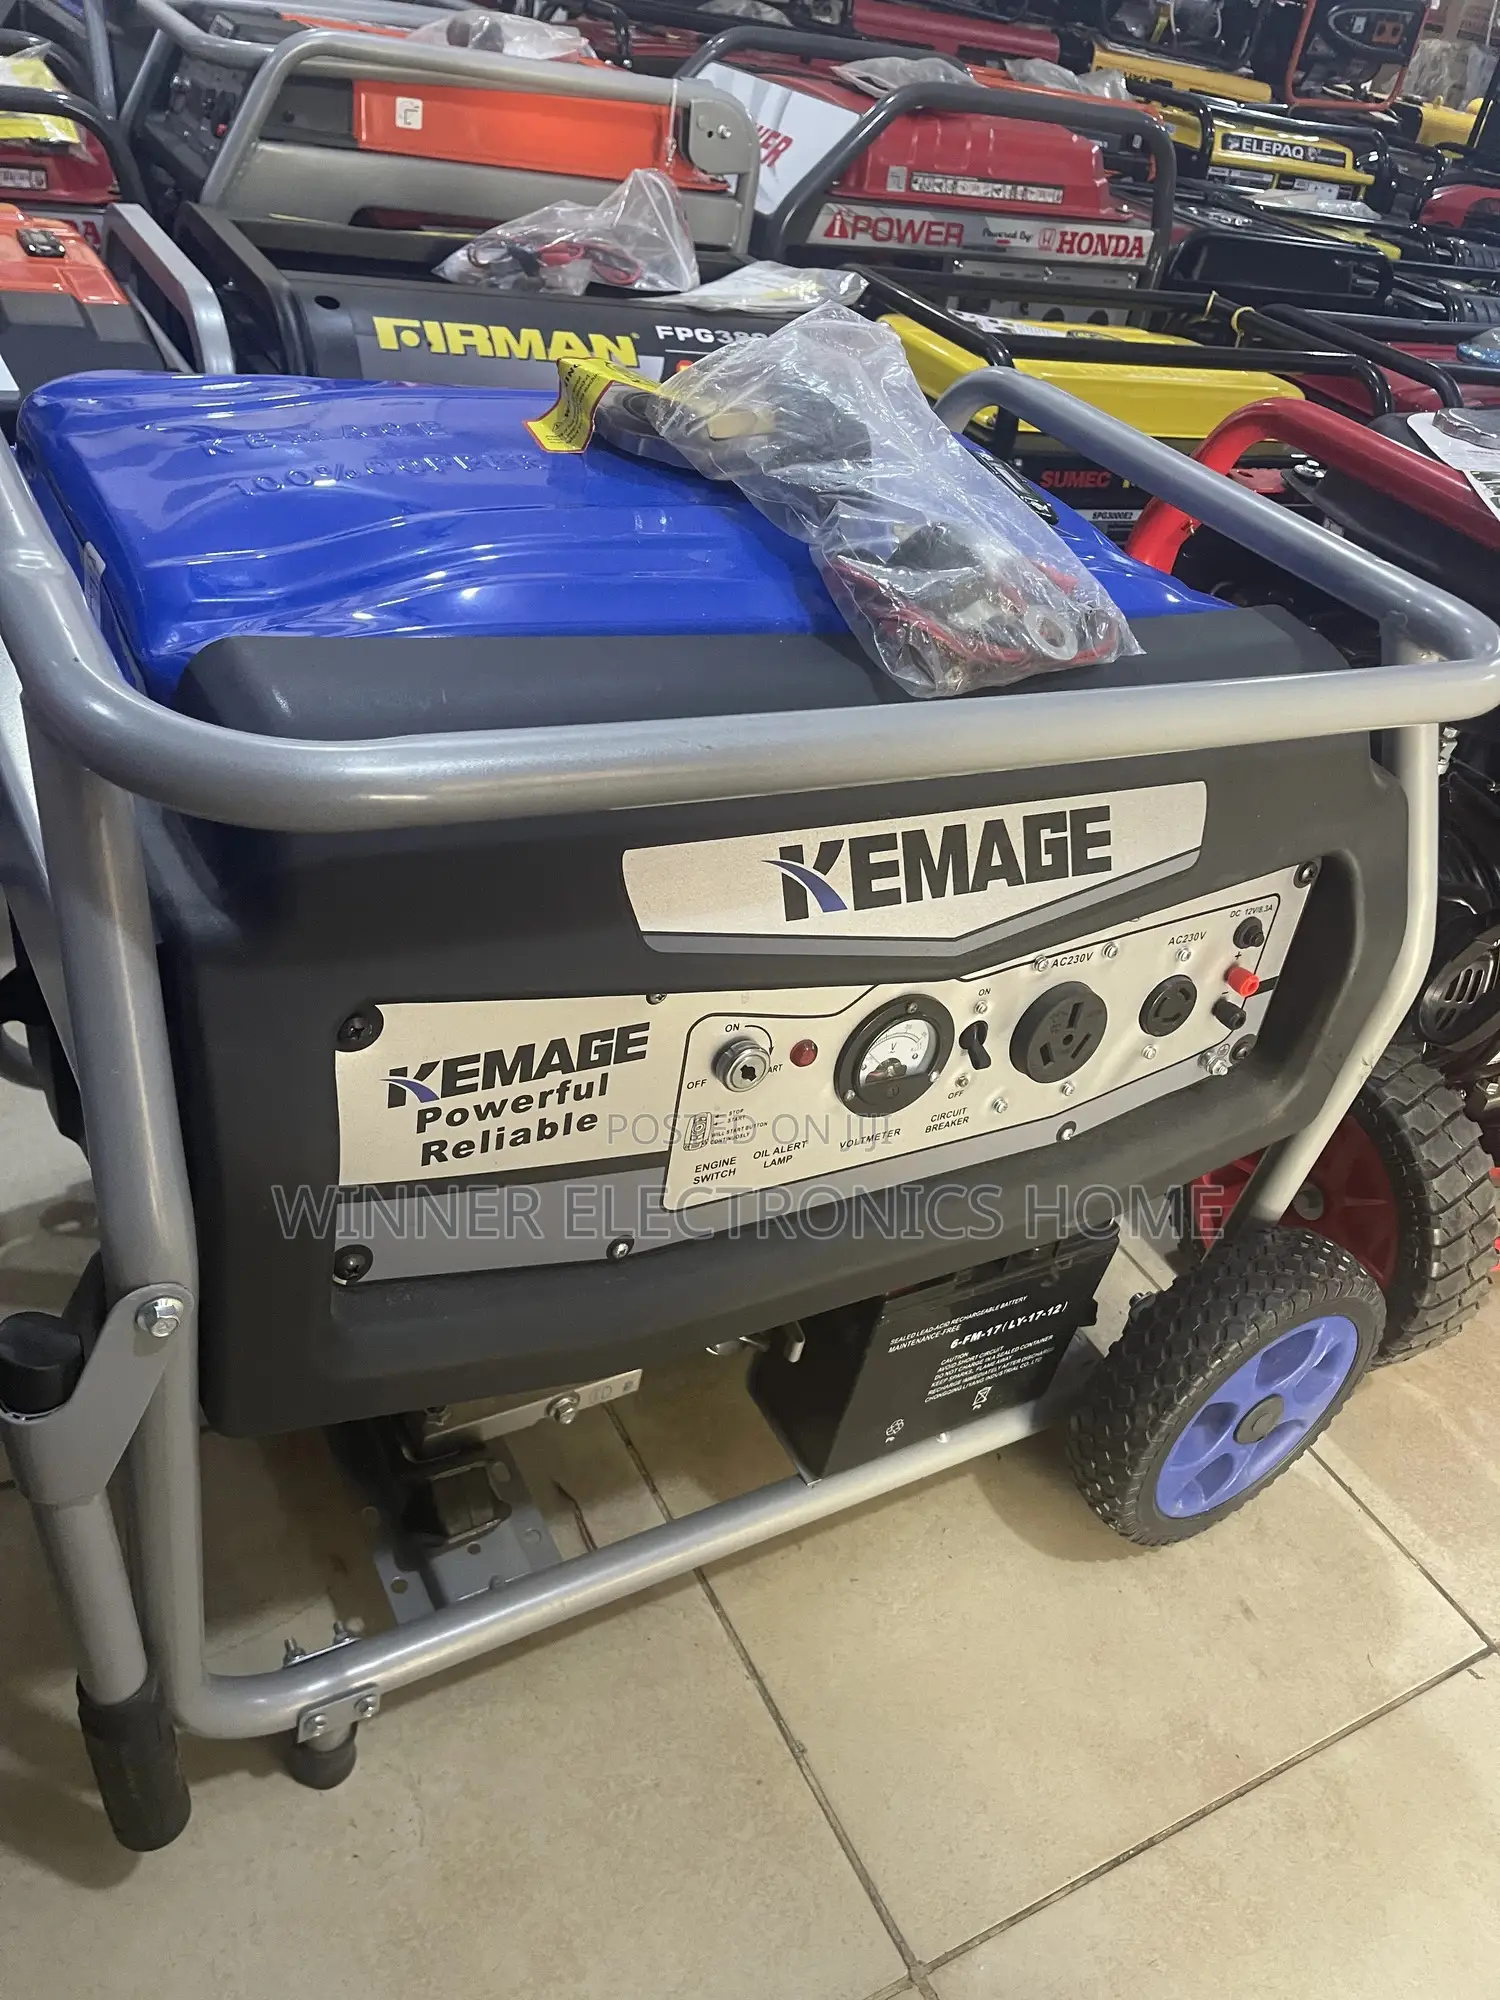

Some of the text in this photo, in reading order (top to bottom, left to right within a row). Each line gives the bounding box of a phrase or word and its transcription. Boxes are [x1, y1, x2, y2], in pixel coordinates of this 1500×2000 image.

[1242, 138, 1304, 160] ELEPAQ
[1056, 230, 1145, 259] HONDA
[372, 316, 639, 368] FIRMAN
[1040, 470, 1112, 488] SUMEC
[761, 805, 1112, 922] KEMAGE
[1229, 910, 1241, 918] DC
[1168, 931, 1207, 946] AC230V
[1051, 951, 1094, 969] AC230V
[979, 987, 991, 996] ON
[724, 1023, 740, 1033] ON
[378, 1022, 650, 1109] KEMAGE
[767, 1063, 783, 1074] ART
[686, 1078, 707, 1090] OFF
[416, 1072, 609, 1134] Powerful
[947, 1089, 965, 1100] OFF
[930, 1107, 968, 1123] CIRCUIT
[925, 1116, 970, 1134] BREAKER
[420, 1112, 598, 1167] Reliable
[839, 1128, 902, 1149] VOLTMETER
[753, 1140, 808, 1160] OIL ALERT
[695, 1156, 737, 1174] ENGINE
[763, 1154, 793, 1169] LAMP
[693, 1168, 737, 1185] SWITCH
[890, 1332, 917, 1346] SEALED
[950, 1304, 1001, 1326] RECHARGEABLE
[1000, 1295, 1028, 1310] BATTERY
[887, 1323, 962, 1354] MAINTENANCE-FREE
[934, 1372, 945, 1381] DO
[1019, 1334, 1055, 1351] CONTAINER
[937, 1345, 1005, 1374] AVOID SHORT CIRCUIT
[940, 1351, 970, 1366] CAUTION
